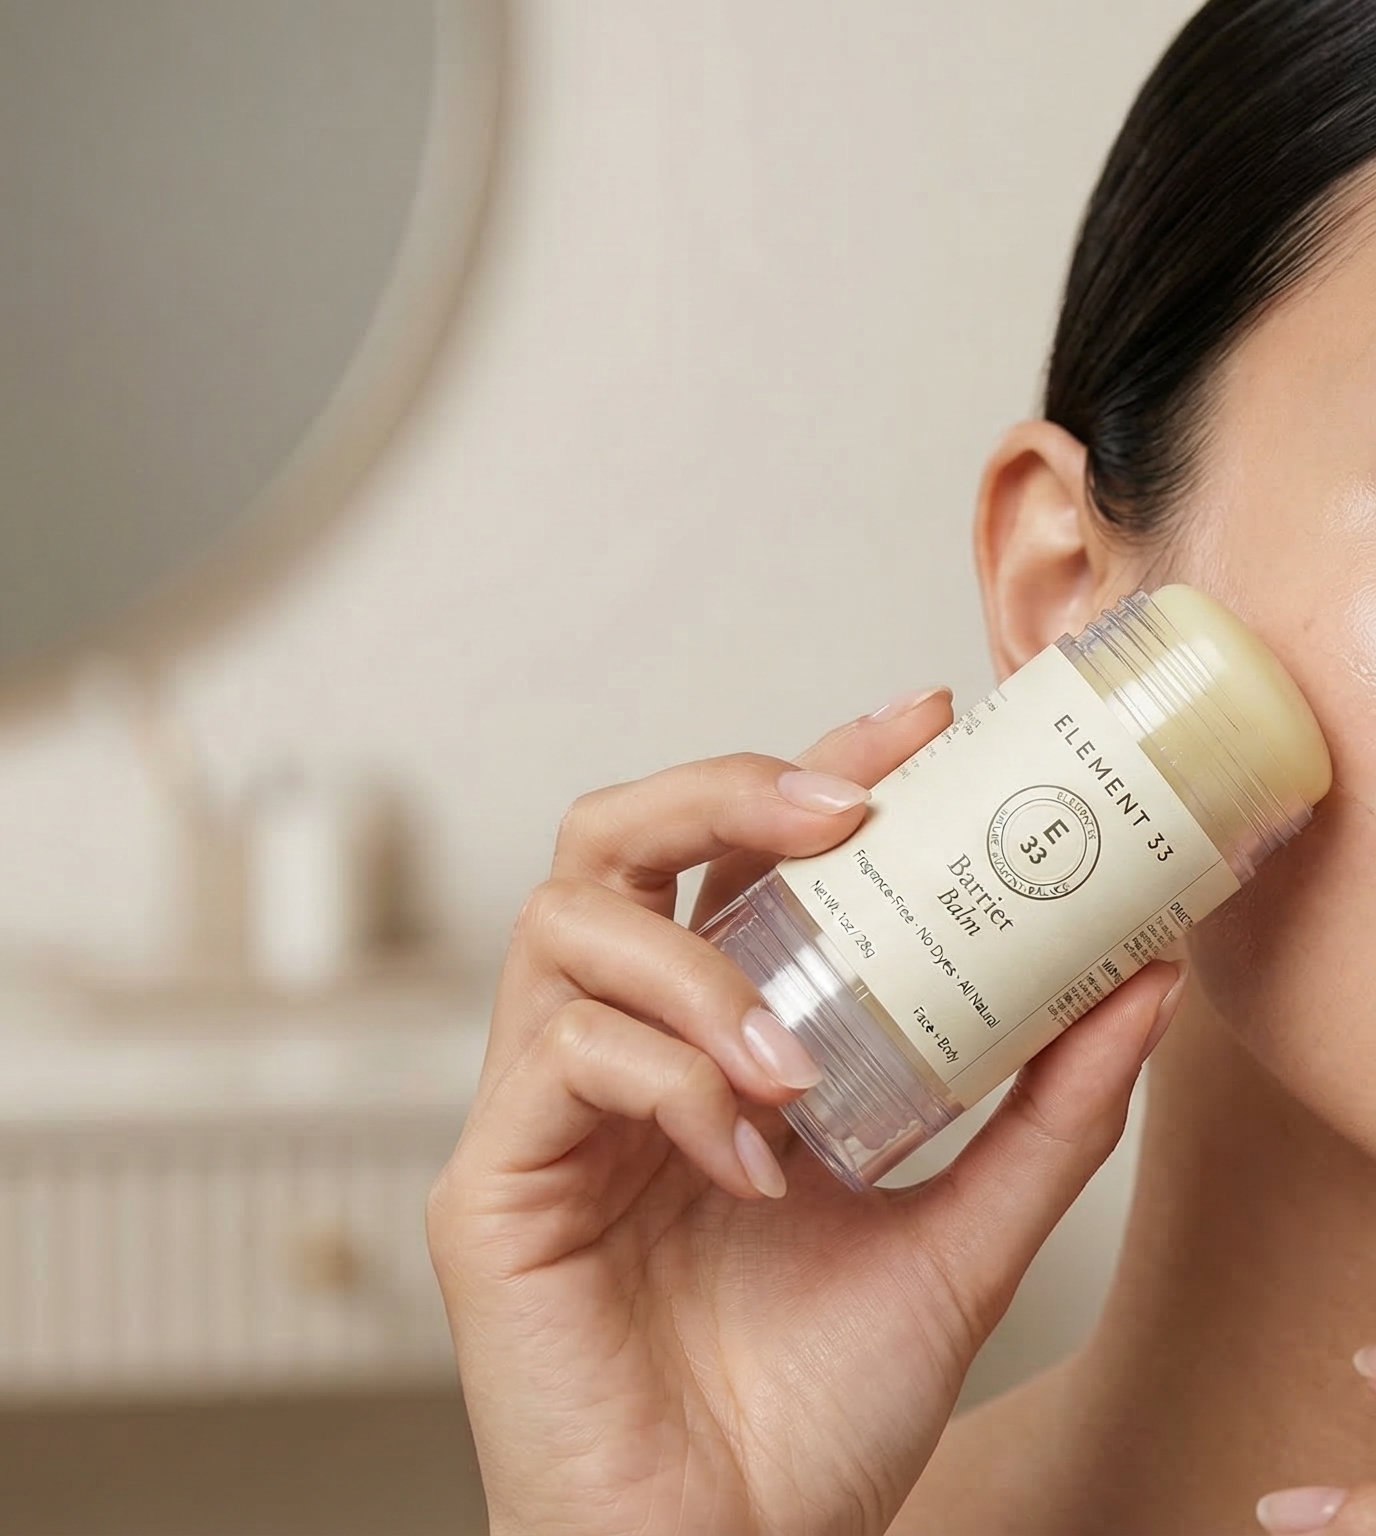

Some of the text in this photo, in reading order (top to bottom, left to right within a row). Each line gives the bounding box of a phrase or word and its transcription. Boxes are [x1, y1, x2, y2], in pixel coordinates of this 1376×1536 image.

[1054, 714, 1150, 826] ELEMENT
[1147, 832, 1174, 863] 33
[1020, 836, 1047, 864] 33
[1043, 819, 1070, 845] E
[937, 887, 980, 938] Balm
[916, 927, 933, 946] No
[930, 945, 956, 976] Dyes
[957, 979, 978, 997] All
[913, 1007, 934, 1033] Face
